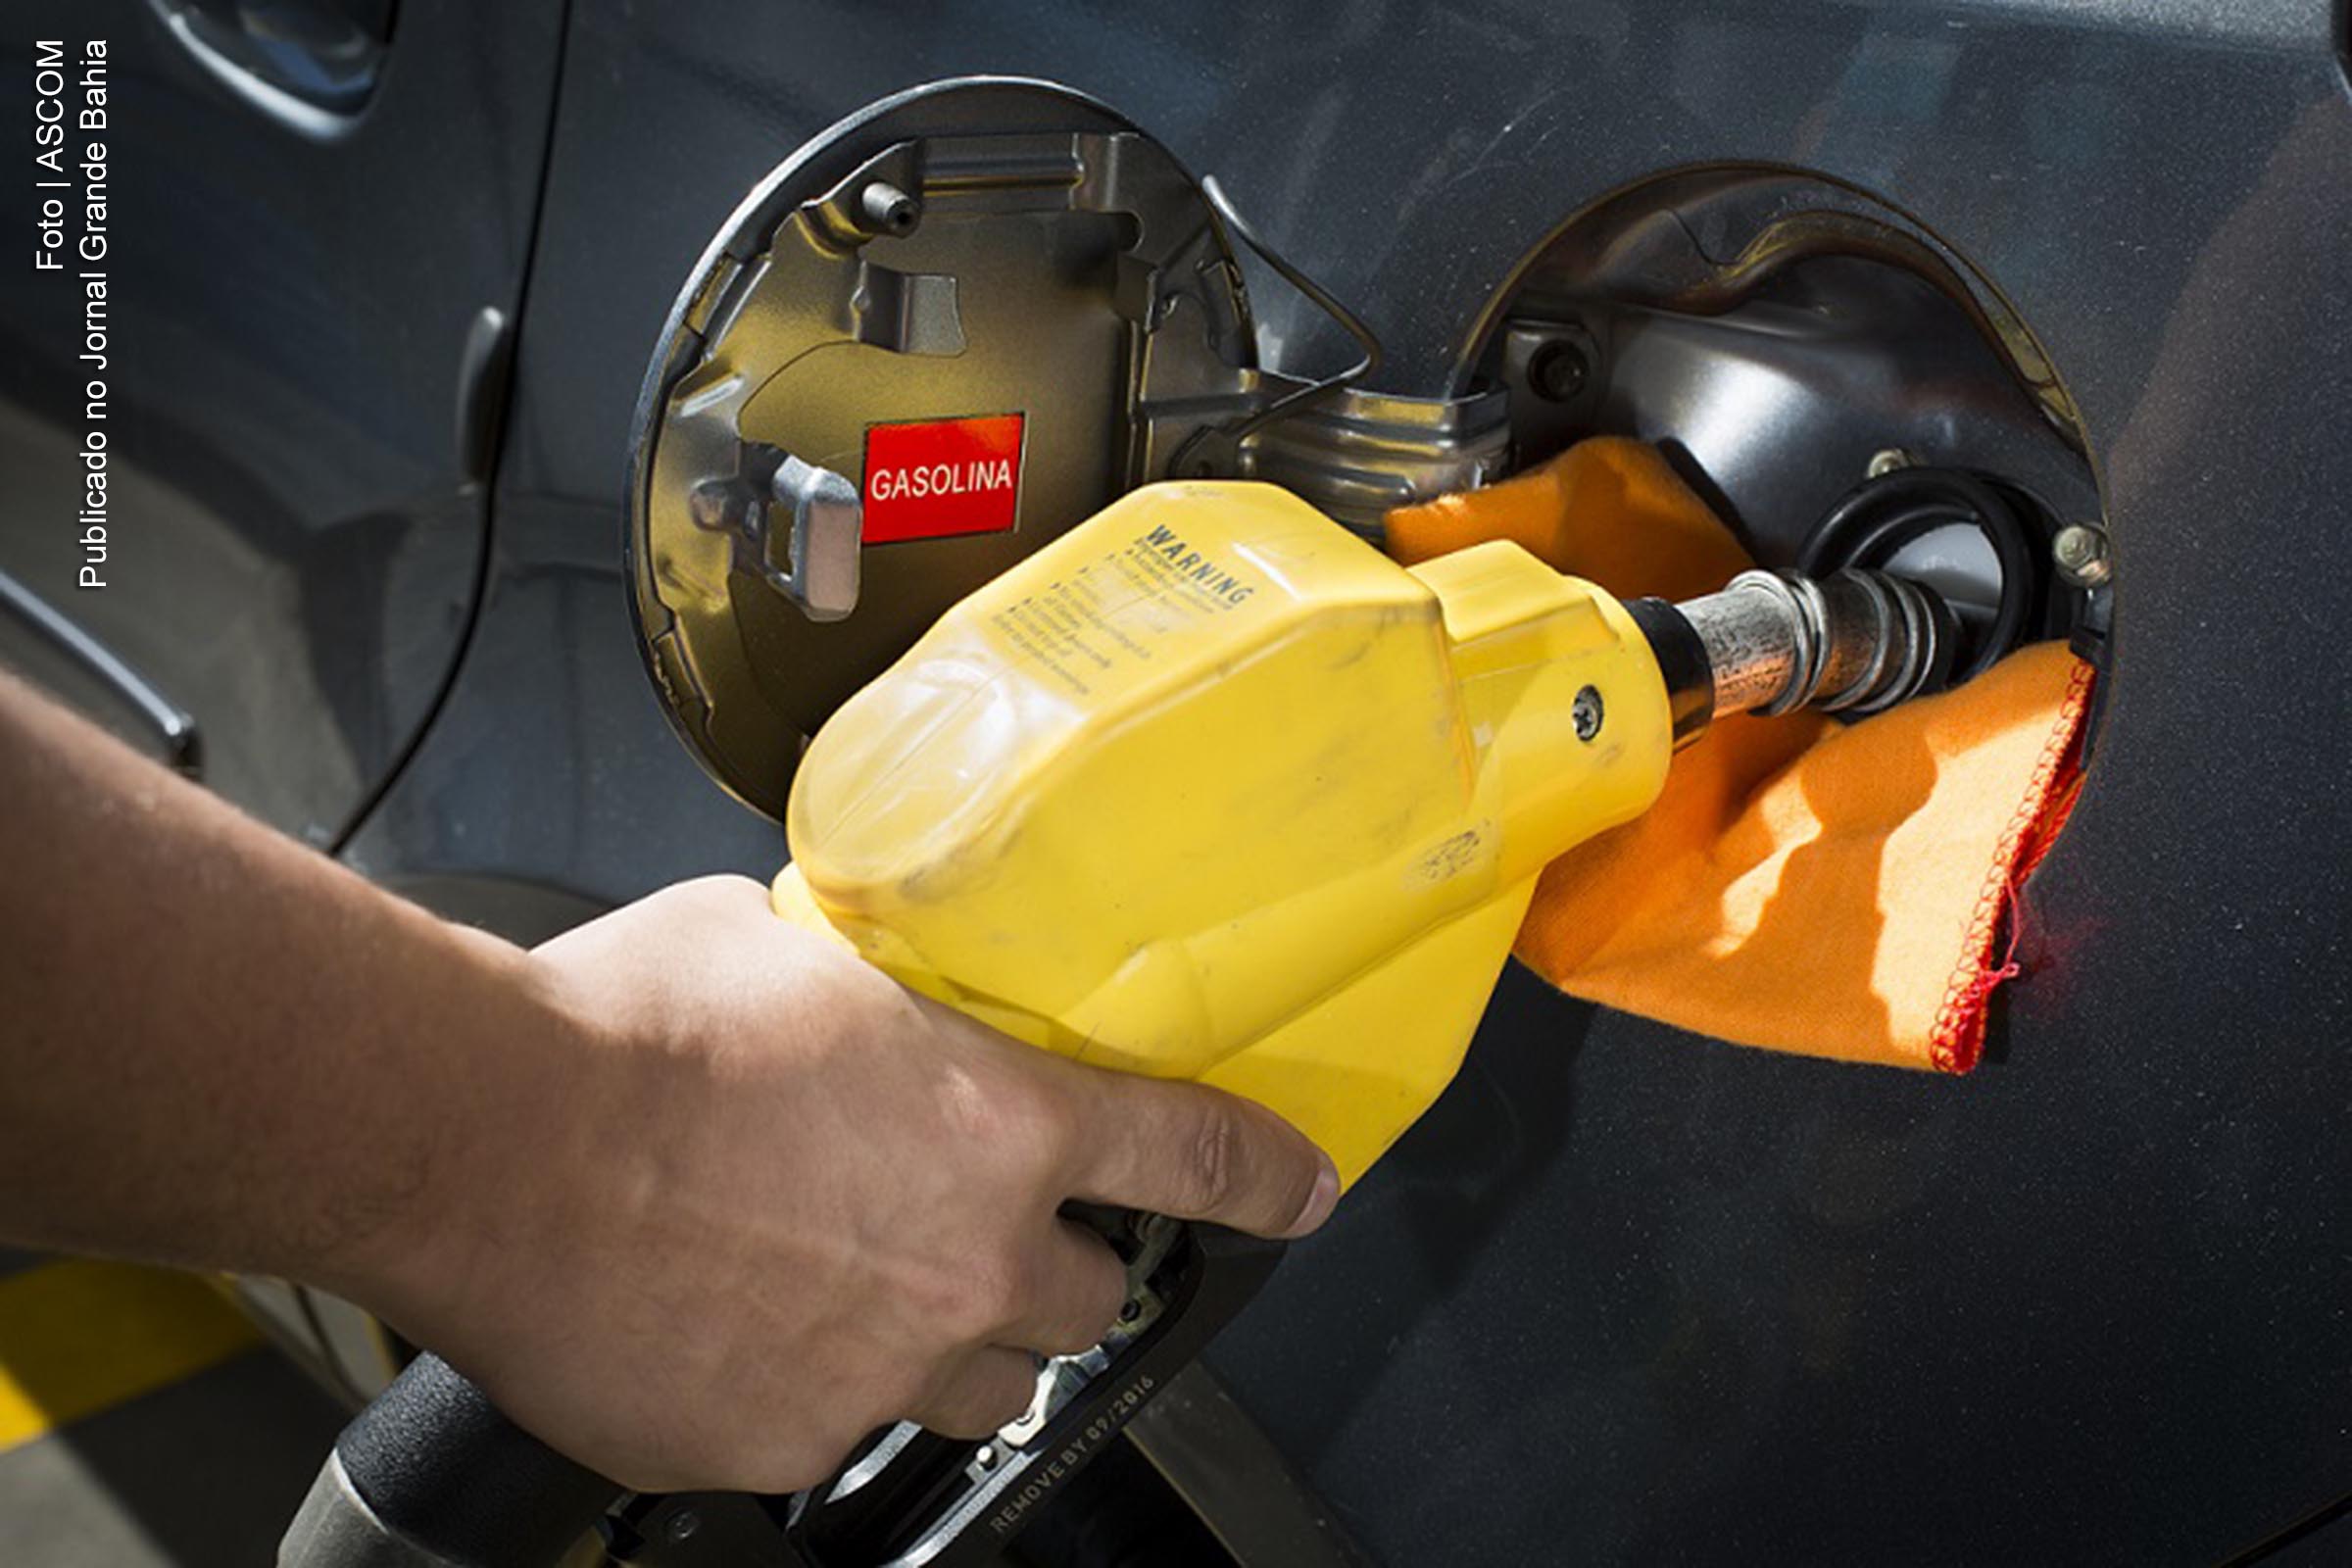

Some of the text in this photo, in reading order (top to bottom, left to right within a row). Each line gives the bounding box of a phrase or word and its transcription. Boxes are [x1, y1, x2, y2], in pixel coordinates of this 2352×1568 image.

[870, 458, 1013, 502] GASOLINA
[1146, 523, 1254, 605] WARNING
[990, 1375, 1154, 1533] REMOVE BY 09/2016
